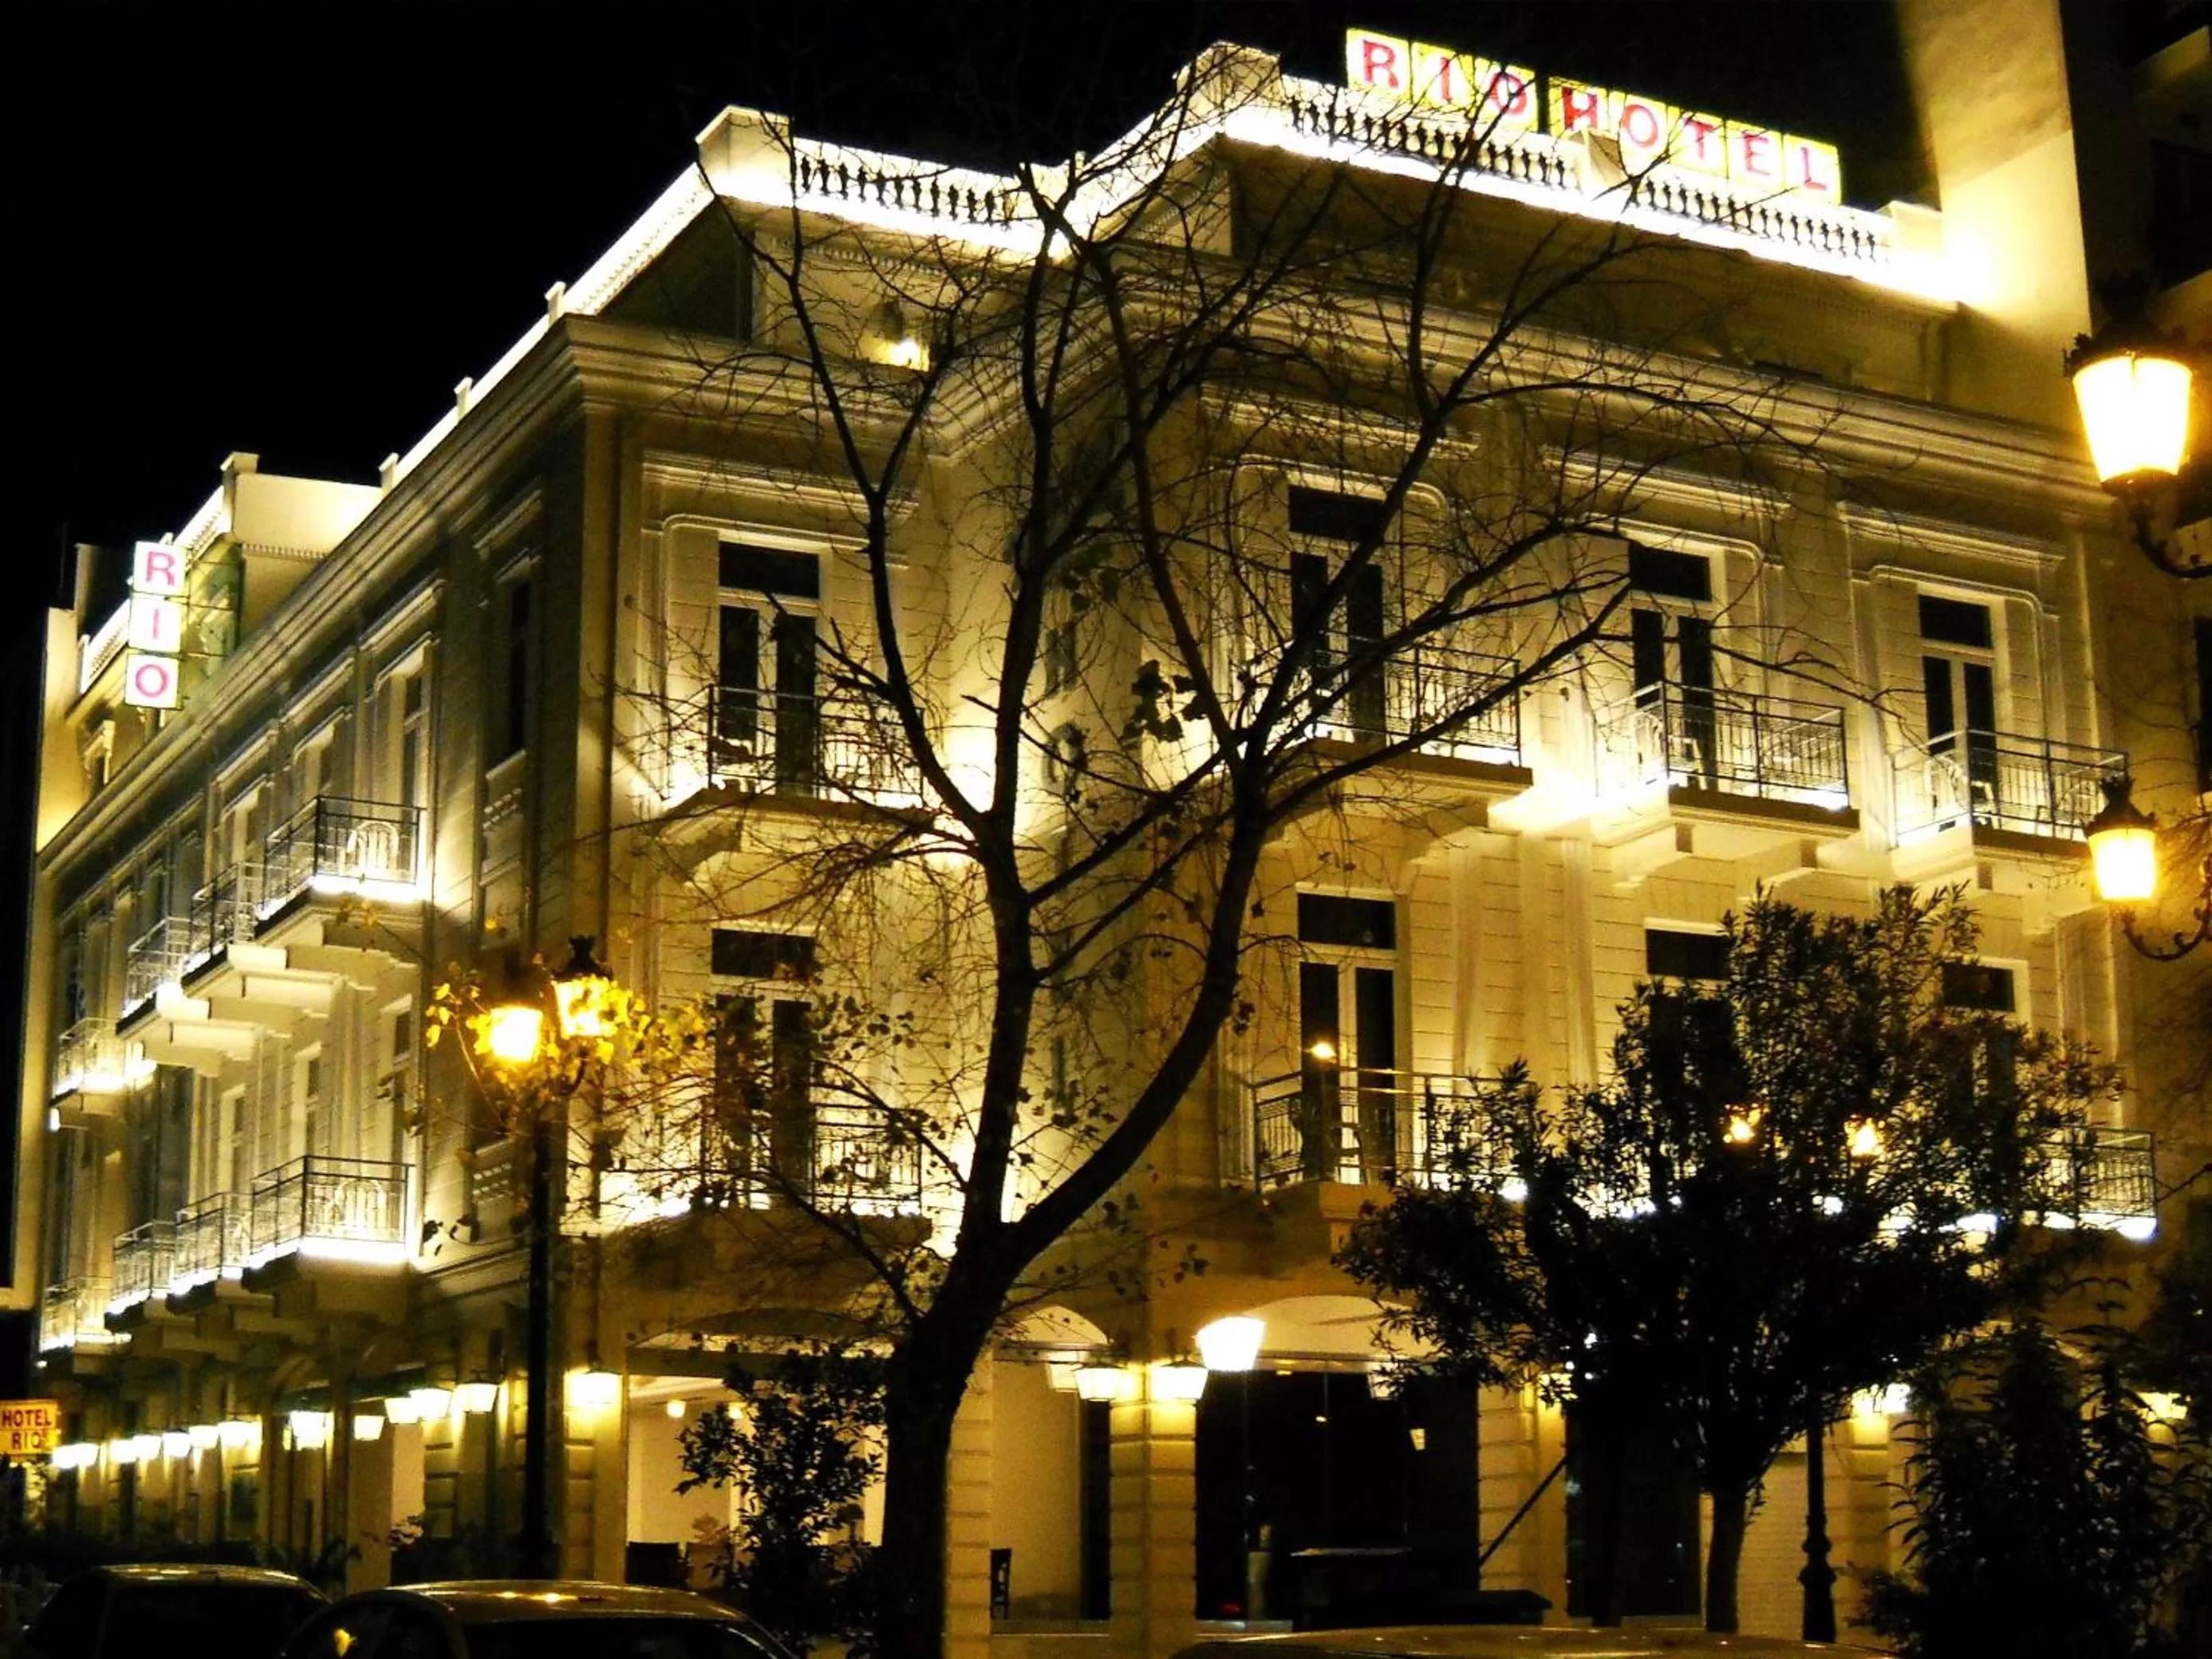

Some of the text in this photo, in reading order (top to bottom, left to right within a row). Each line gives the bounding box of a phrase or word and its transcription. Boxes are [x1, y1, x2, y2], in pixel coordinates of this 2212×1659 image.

[1362, 38, 1828, 191] RIO HOTEL
[135, 550, 175, 699] RIO
[2, 1409, 52, 1427] HOTEL
[12, 1432, 41, 1449] RIO
